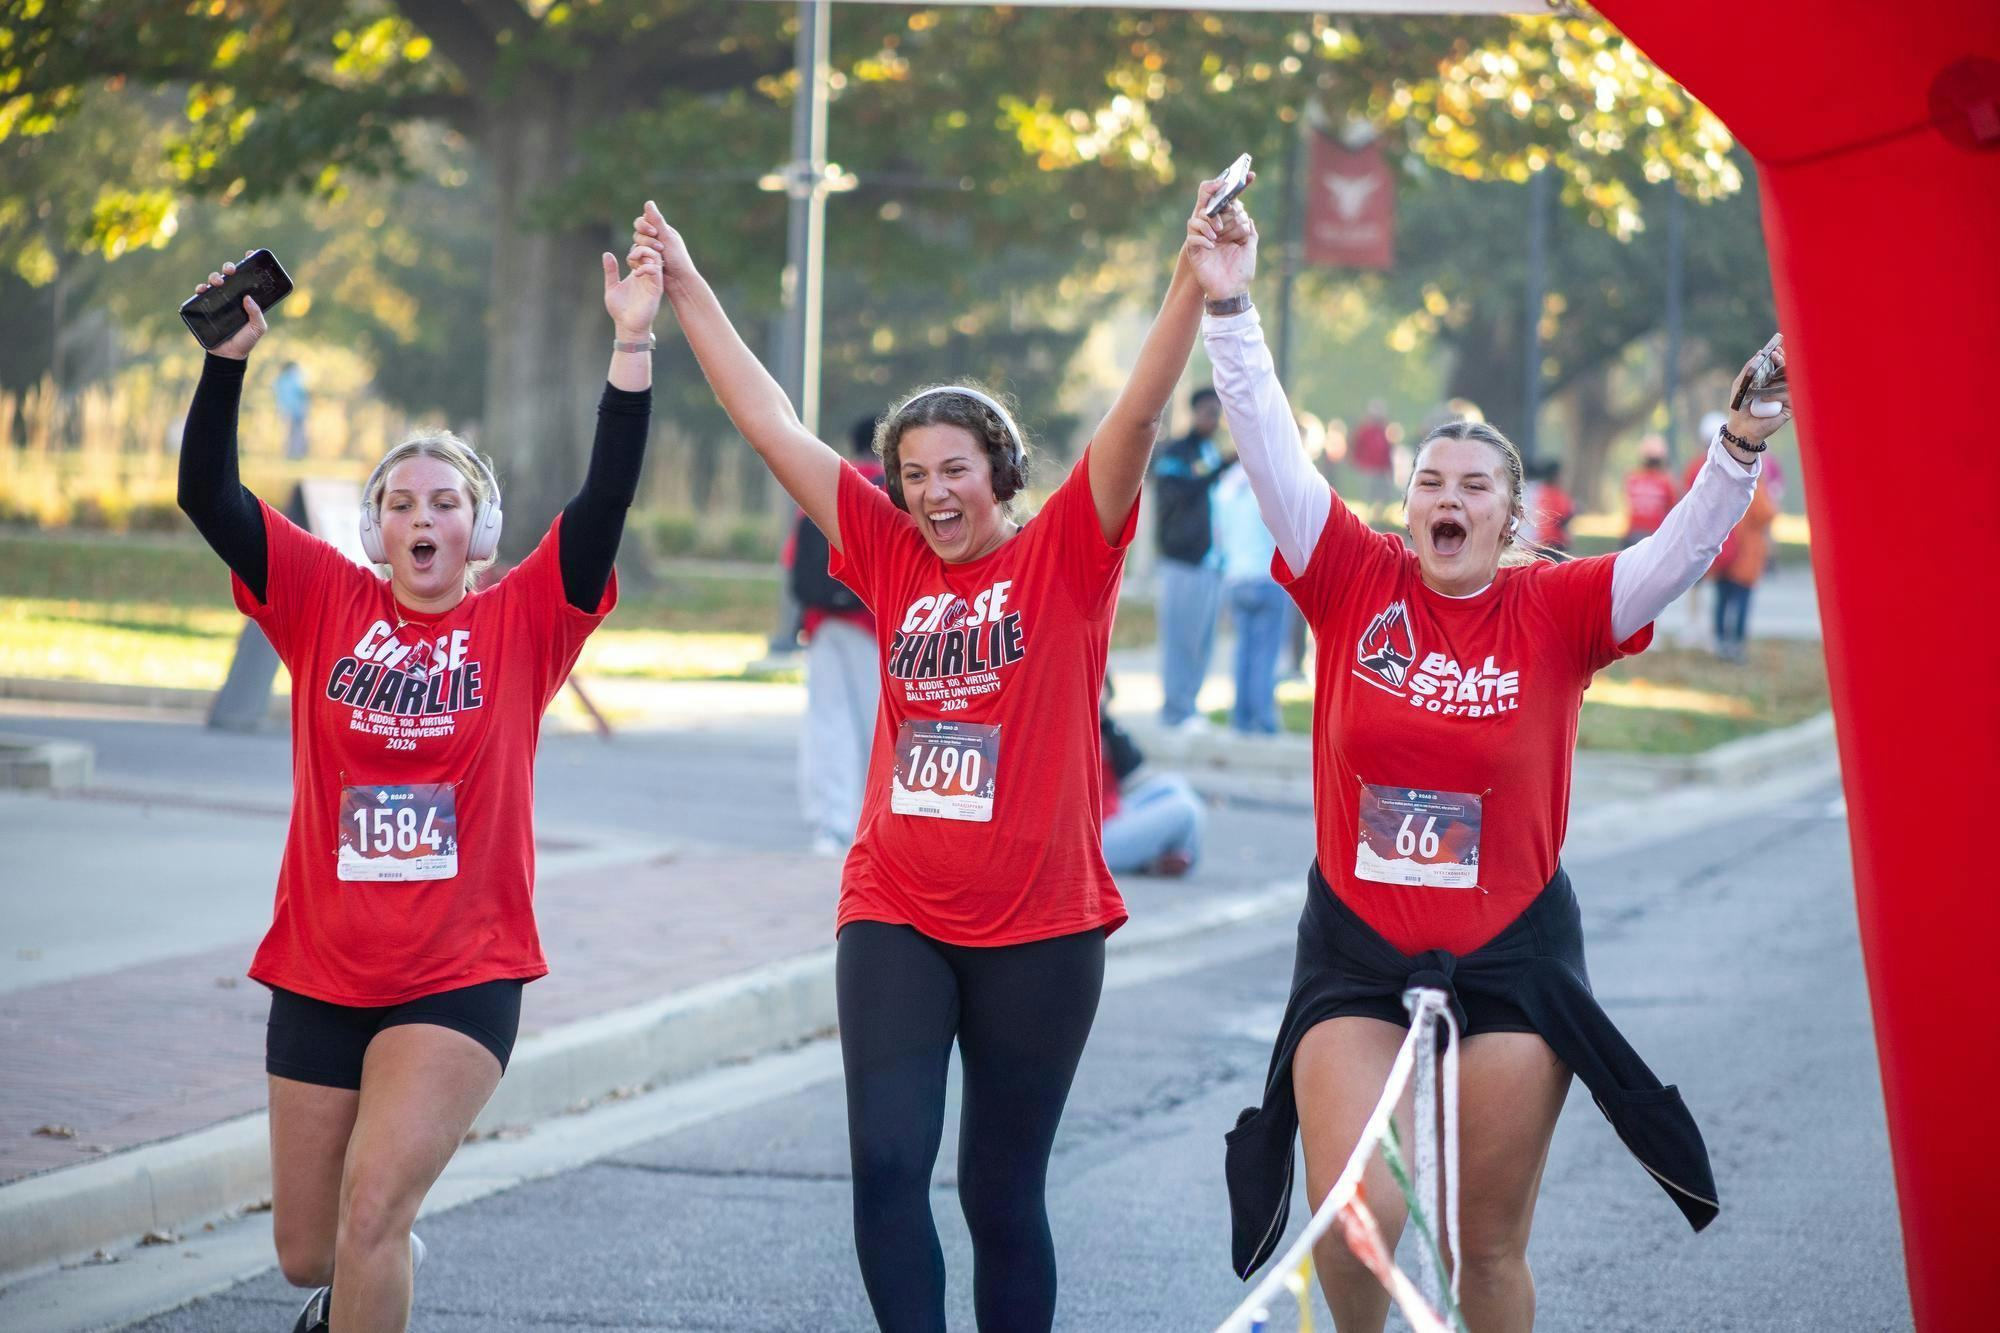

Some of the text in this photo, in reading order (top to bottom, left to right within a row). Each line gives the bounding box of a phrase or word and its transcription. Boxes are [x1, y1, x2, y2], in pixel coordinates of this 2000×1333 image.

[888, 610, 1025, 679] CHARLIE
[1418, 650, 1501, 684] BALL
[326, 656, 483, 716] CHARLIE
[904, 672, 1000, 691] 5K KIDDIE 100 VIRTUAL
[906, 681, 1001, 701] BALL STATE UNIVERSITY
[1408, 670, 1519, 703] STATE
[352, 709, 455, 727] 5K KIDDIE 100 VIRTUAL
[940, 698, 969, 712] 2026
[1409, 694, 1519, 718] SOFTBALL
[349, 720, 455, 737] BALL STATE UNIVERSITY
[384, 737, 417, 750] 2026
[906, 745, 982, 792] 1690
[353, 806, 442, 853] 1584
[1395, 813, 1440, 858] 66
